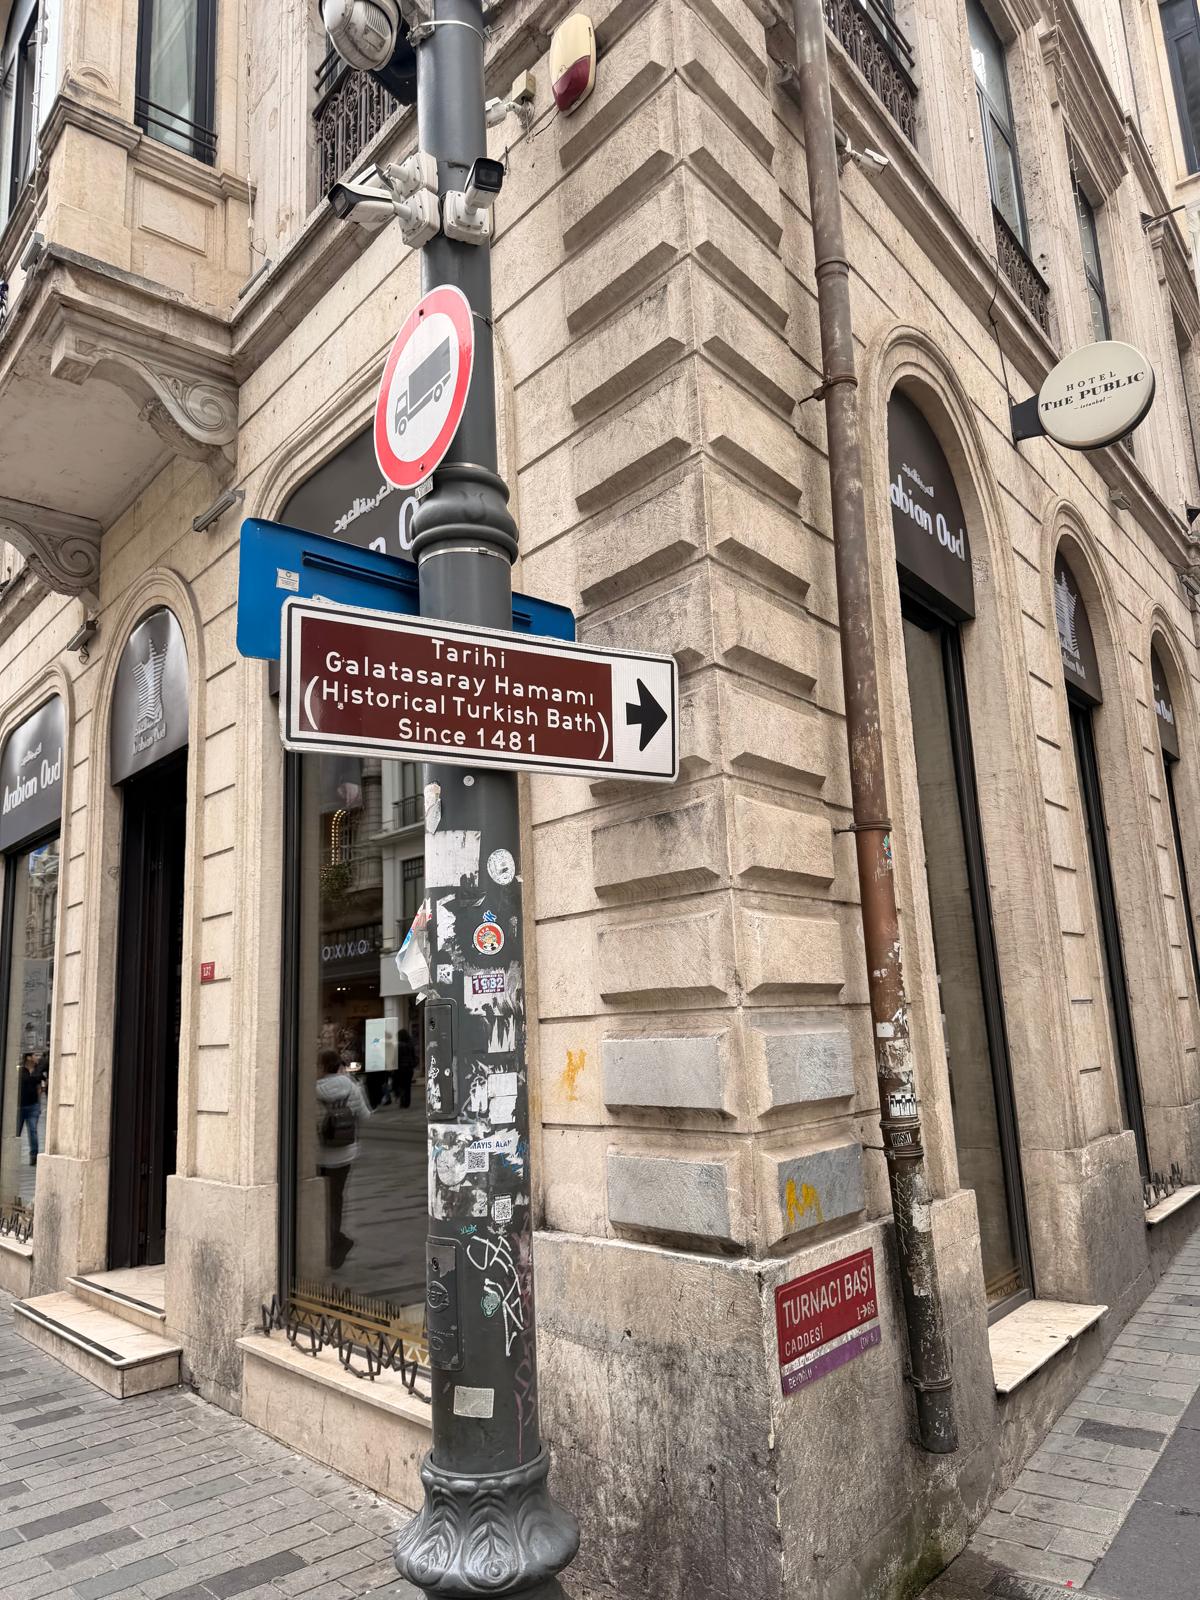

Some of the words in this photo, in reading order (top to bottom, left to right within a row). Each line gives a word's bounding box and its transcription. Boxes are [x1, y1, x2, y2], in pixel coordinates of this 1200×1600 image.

[1041, 395, 1073, 411] THE
[1079, 371, 1145, 400] PUBLIC
[1066, 371, 1116, 391] HOTEL
[936, 512, 966, 562] Oud
[431, 638, 505, 669] Tarihi
[325, 650, 486, 697] Galatasaray
[495, 674, 594, 706] Hamamı
[303, 675, 445, 731] (Historical
[452, 696, 538, 727] Turkish
[546, 707, 610, 760] Bath)
[398, 717, 467, 746] Since
[477, 727, 536, 753] 1481
[2, 775, 38, 816] Arabian
[41, 747, 62, 789] Oud
[782, 1278, 842, 1329] TURNACI
[844, 1263, 873, 1301] BAŞI
[784, 1321, 824, 1357] CADDESİ
